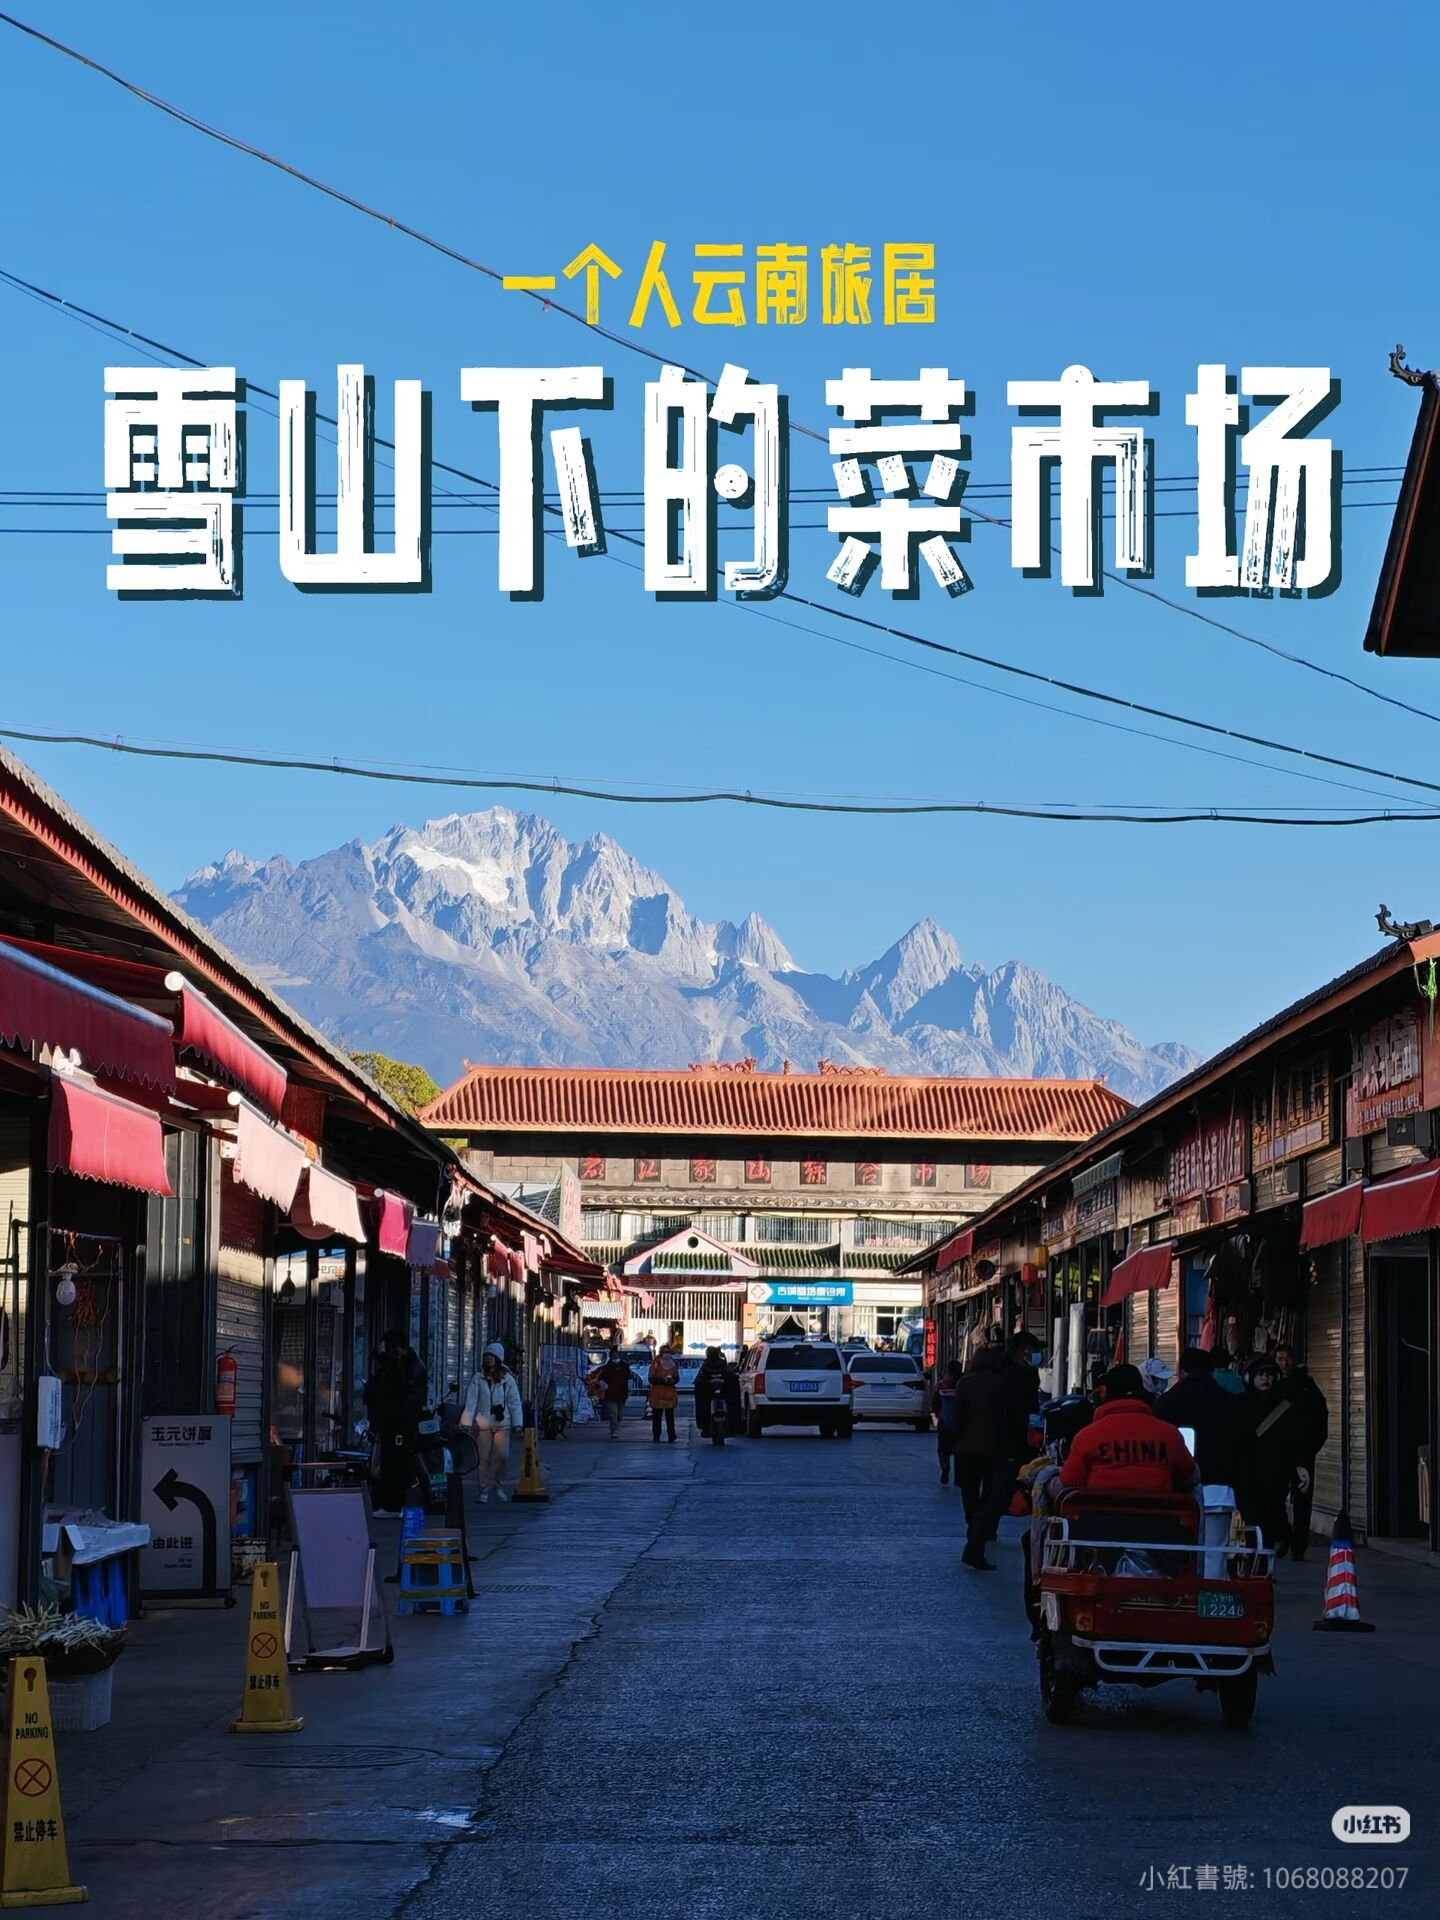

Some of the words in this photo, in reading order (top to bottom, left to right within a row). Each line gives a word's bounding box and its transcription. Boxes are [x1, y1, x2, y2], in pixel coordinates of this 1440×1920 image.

[1098, 1439, 1169, 1465] CHINA
[153, 1536, 192, 1549] 由此进
[253, 1610, 277, 1619] PARKING
[249, 1675, 280, 1690] 禁止停车
[24, 1712, 38, 1724] NO
[15, 1726, 49, 1740] PARKING
[13, 1820, 58, 1843] 禁止停车
